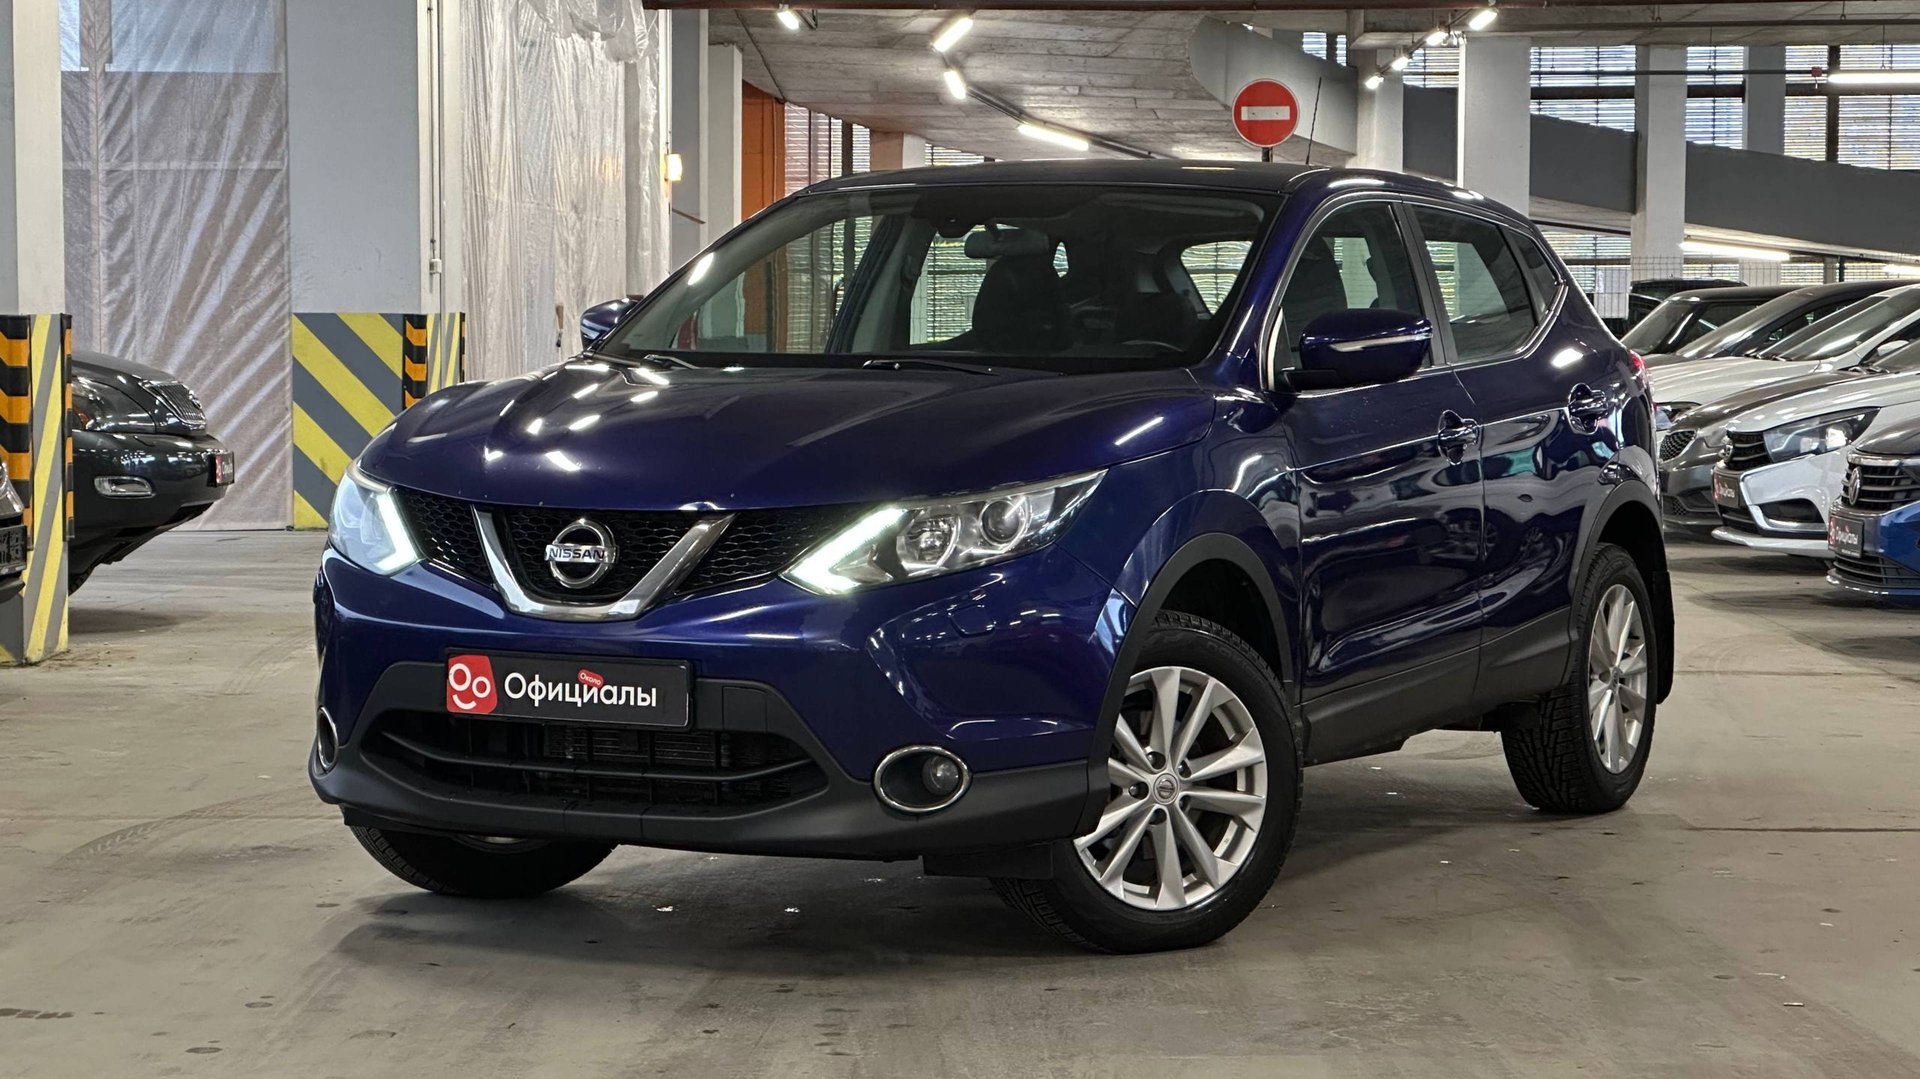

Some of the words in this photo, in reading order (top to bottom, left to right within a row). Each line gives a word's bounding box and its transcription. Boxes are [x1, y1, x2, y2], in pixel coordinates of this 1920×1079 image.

[549, 547, 606, 560] NISSAN
[580, 672, 602, 686] Около
[504, 672, 656, 707] Официалы
